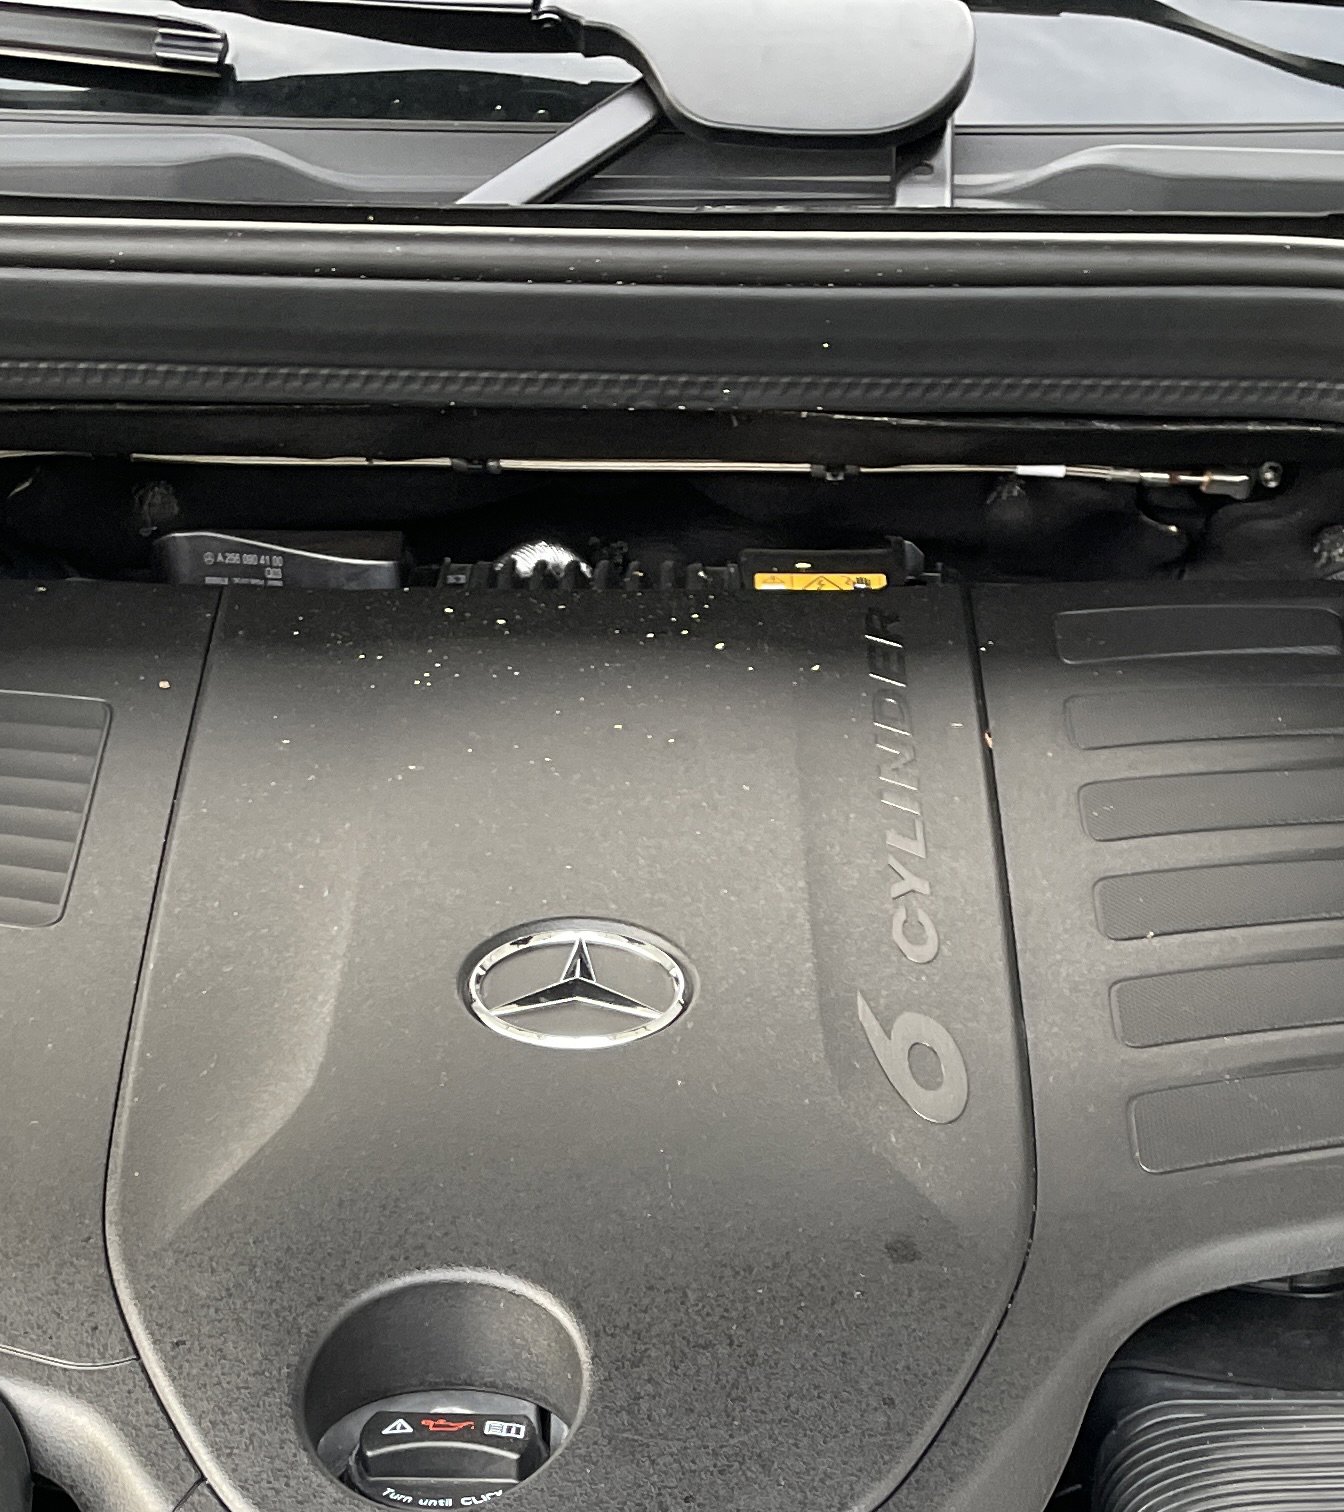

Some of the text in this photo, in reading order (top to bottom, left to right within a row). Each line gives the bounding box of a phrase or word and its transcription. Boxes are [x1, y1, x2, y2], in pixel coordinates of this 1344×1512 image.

[857, 606, 969, 1125] 6 CYLINDER
[382, 1486, 414, 1504] Turn
[417, 1497, 453, 1507] until
